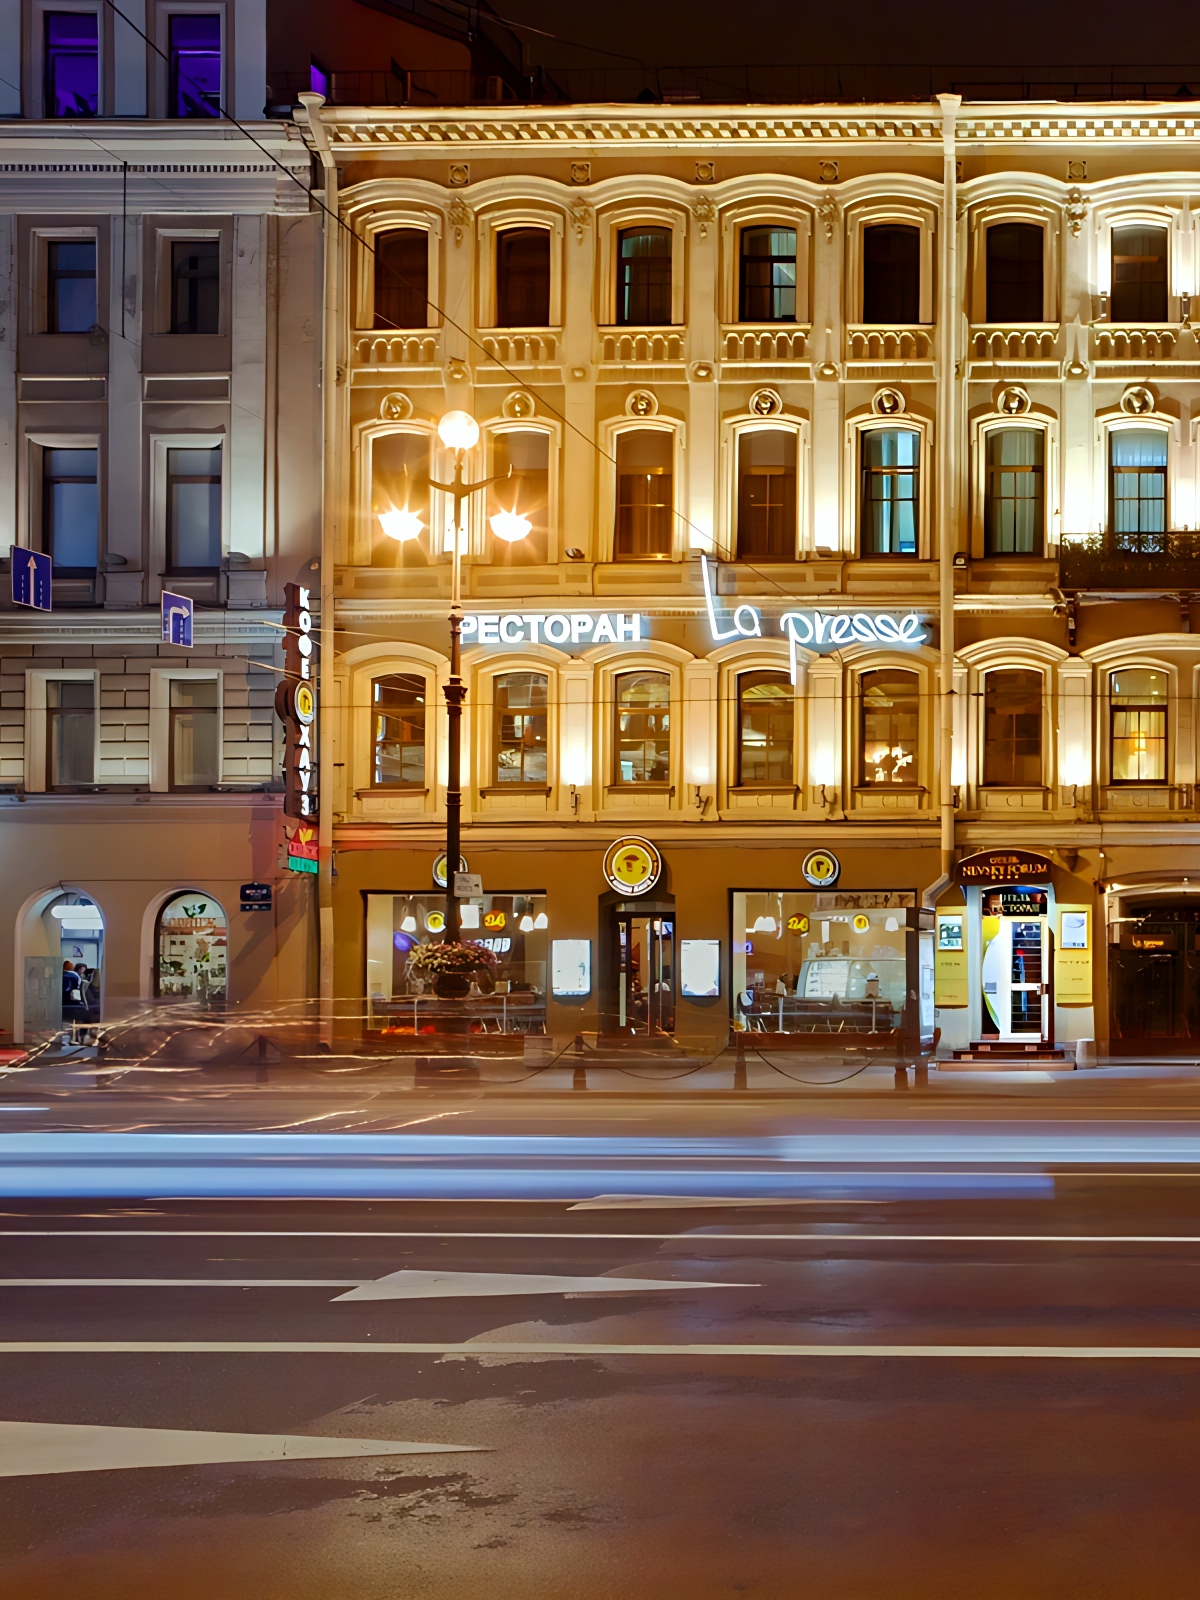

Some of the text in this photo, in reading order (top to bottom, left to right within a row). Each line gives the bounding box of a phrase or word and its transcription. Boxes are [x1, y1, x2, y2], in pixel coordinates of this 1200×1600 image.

[458, 613, 641, 644] РЕСТОРАН
[701, 554, 928, 685] La presse
